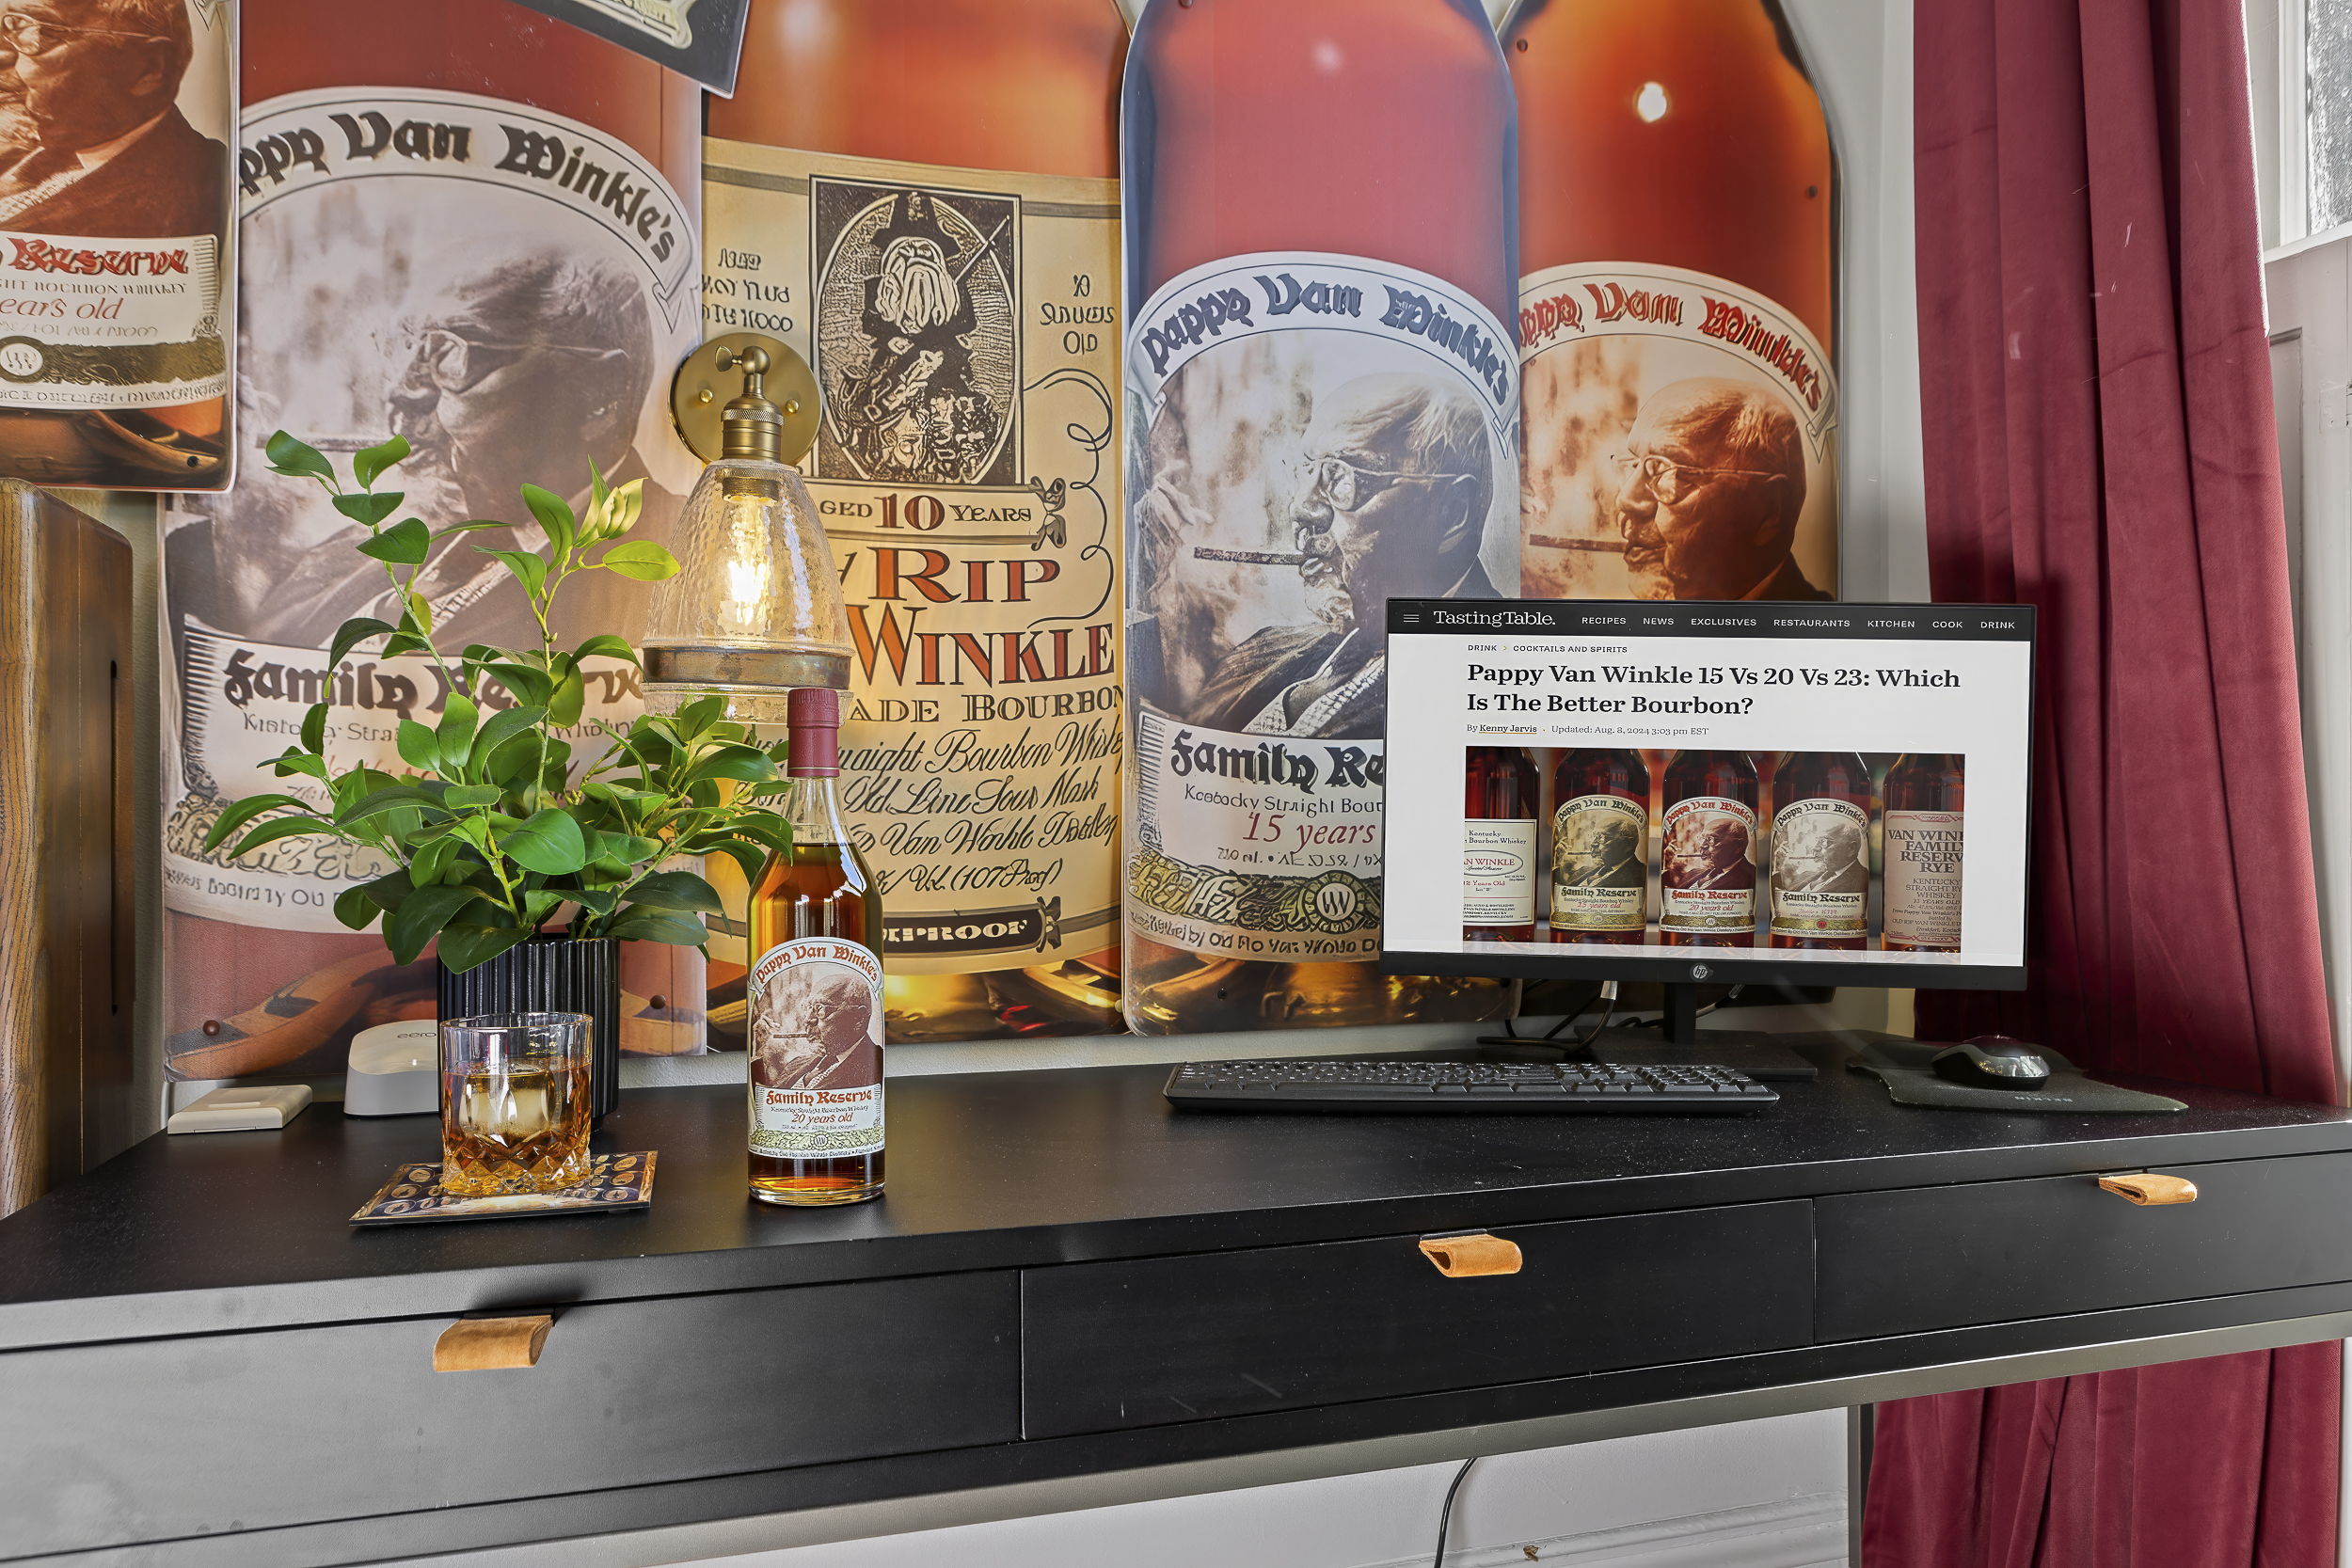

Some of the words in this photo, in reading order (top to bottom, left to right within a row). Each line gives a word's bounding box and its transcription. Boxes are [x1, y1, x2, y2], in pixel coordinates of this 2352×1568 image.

[240, 128, 331, 197] ppy
[328, 110, 471, 163] Van
[494, 123, 675, 263] Winkle's
[1252, 273, 1363, 318] Van
[76, 297, 124, 320] old
[817, 500, 873, 518] GED
[874, 493, 946, 531] 10
[867, 546, 1061, 604] RIP
[1643, 617, 1675, 626] NEWS
[1691, 617, 1756, 626] EXCLUSIVES
[1773, 618, 1851, 627] RESTAURANTS
[1867, 619, 1915, 628] KITCHEN
[1932, 620, 1963, 629] COOK
[1980, 621, 2015, 629] DRINK
[845, 601, 1115, 688] WINKLE
[1590, 645, 1628, 654] SPIRITS
[1468, 664, 1544, 686] Pappy
[1548, 665, 1596, 683] Van
[1601, 665, 1692, 684] Winkle
[1698, 667, 1723, 684] 15
[1729, 667, 1758, 685] Vs
[1763, 668, 1794, 686] 20
[1799, 668, 1829, 686] Vs
[1834, 668, 1870, 687] 23:
[1875, 669, 1961, 688] Which
[422, 664, 644, 715] Rerve
[850, 698, 939, 723] ADE
[1468, 693, 1488, 711] Is
[1494, 693, 1541, 711] The
[1547, 694, 1626, 712] Better
[1631, 695, 1754, 714] Bourbon?
[1467, 724, 1478, 733] By
[1480, 724, 1508, 734] Kenny
[1509, 724, 1537, 733] Jarvis
[1551, 725, 1593, 734] Updated:
[1594, 726, 1615, 735] Aug.
[1627, 727, 1649, 736] 2024
[1673, 728, 1688, 736] pm
[1170, 728, 1319, 795] Family
[1341, 798, 1381, 814] Bour
[1582, 800, 1607, 808] Van
[1691, 800, 1715, 809] Van
[1242, 812, 1286, 843] 15
[1290, 823, 1376, 856] years
[1887, 830, 1915, 840] VAN
[1919, 863, 1954, 873] RYE
[1561, 887, 1595, 897] Family
[1596, 888, 1637, 897] Reserve
[1671, 890, 1705, 900] Family
[1707, 890, 1747, 900] Reserve
[1783, 892, 1818, 903] Family
[1819, 894, 1861, 903] Reserve
[755, 952, 791, 984] Pappy
[792, 945, 826, 959] Van
[833, 945, 877, 982] Winkle's
[1694, 964, 1708, 978] hp
[766, 1090, 814, 1106] Family
[816, 1090, 872, 1104] Reserve
[791, 1113, 805, 1123] 20
[806, 1114, 835, 1126] years
[837, 1112, 853, 1122] old
